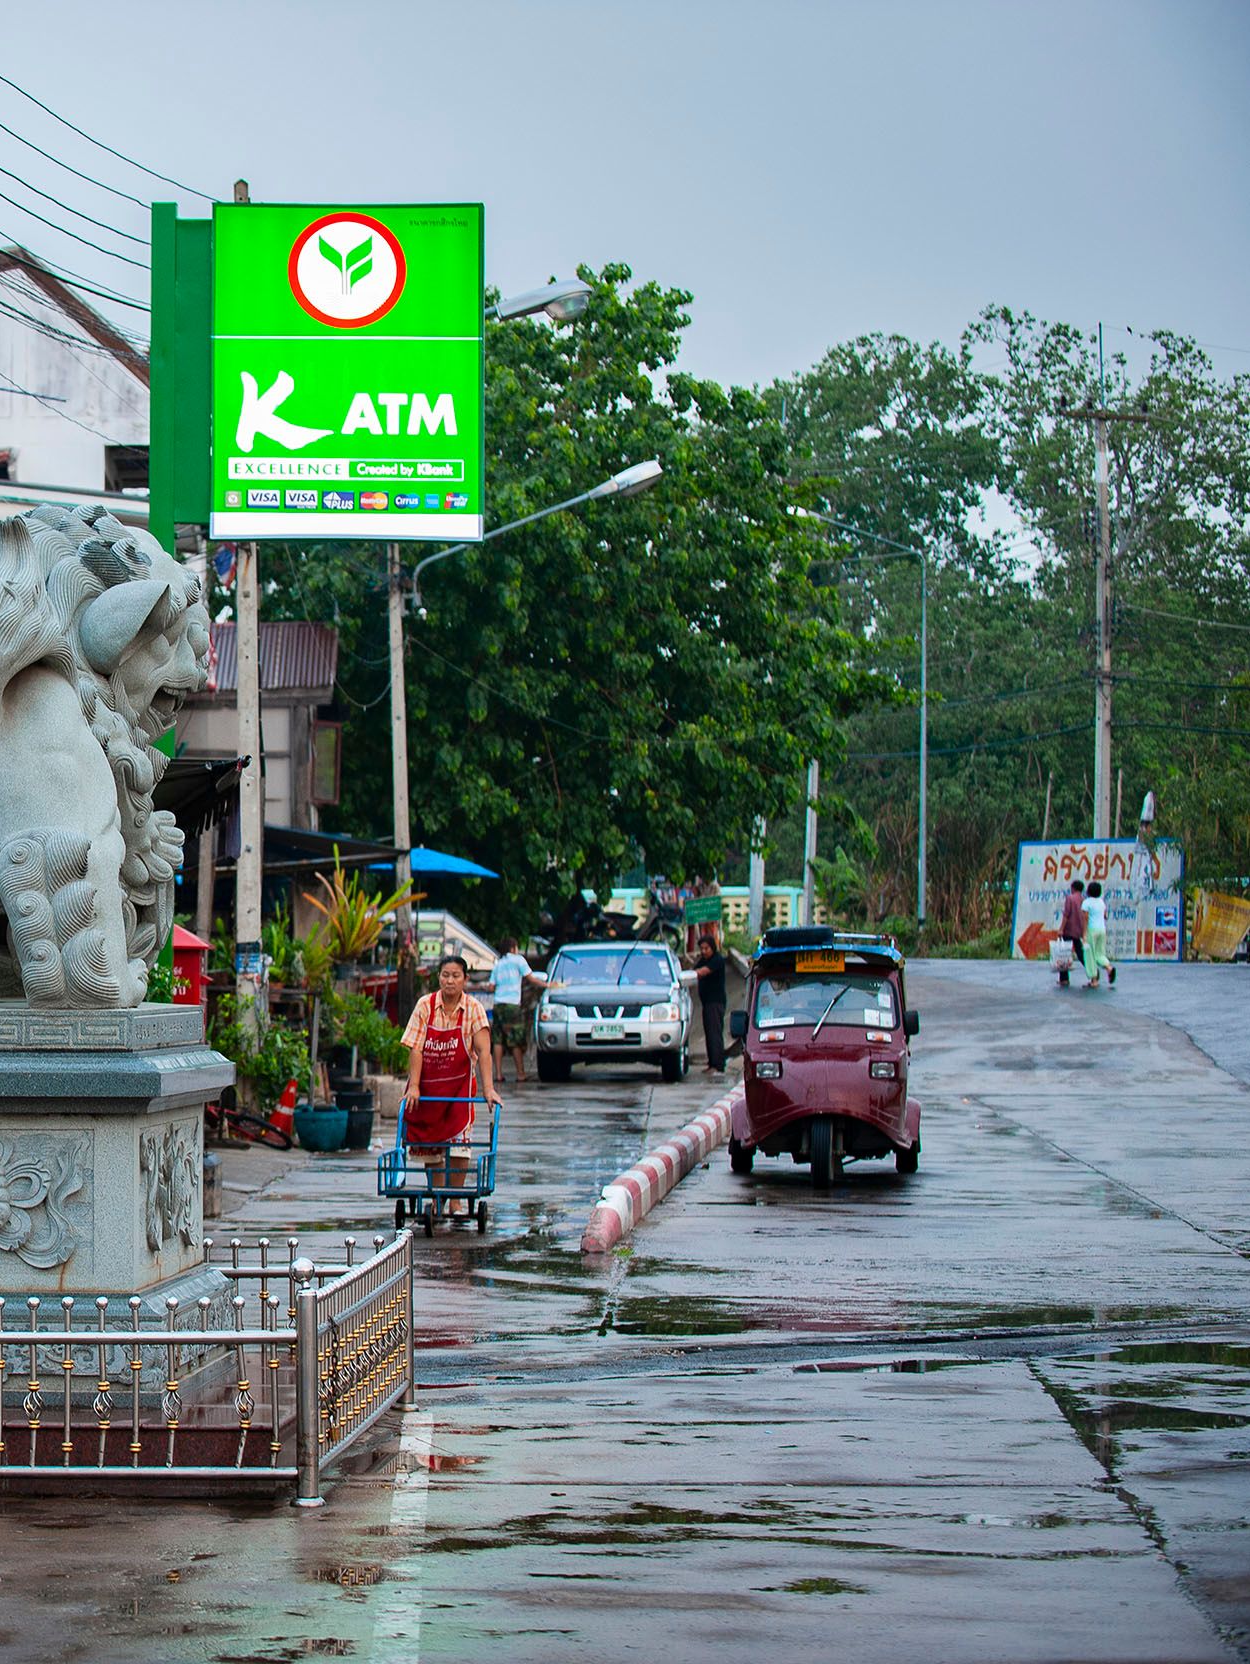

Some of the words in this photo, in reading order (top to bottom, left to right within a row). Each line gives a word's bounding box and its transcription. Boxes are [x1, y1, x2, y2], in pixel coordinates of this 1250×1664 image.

[235, 370, 335, 453] K
[340, 393, 458, 435] ATM
[234, 463, 342, 475] EXCELLENCE
[357, 463, 398, 475] Created
[400, 463, 414, 476] by
[416, 463, 454, 476] KBank
[251, 493, 278, 502] VISA
[288, 493, 316, 502] VISA
[332, 499, 354, 509] PLUS
